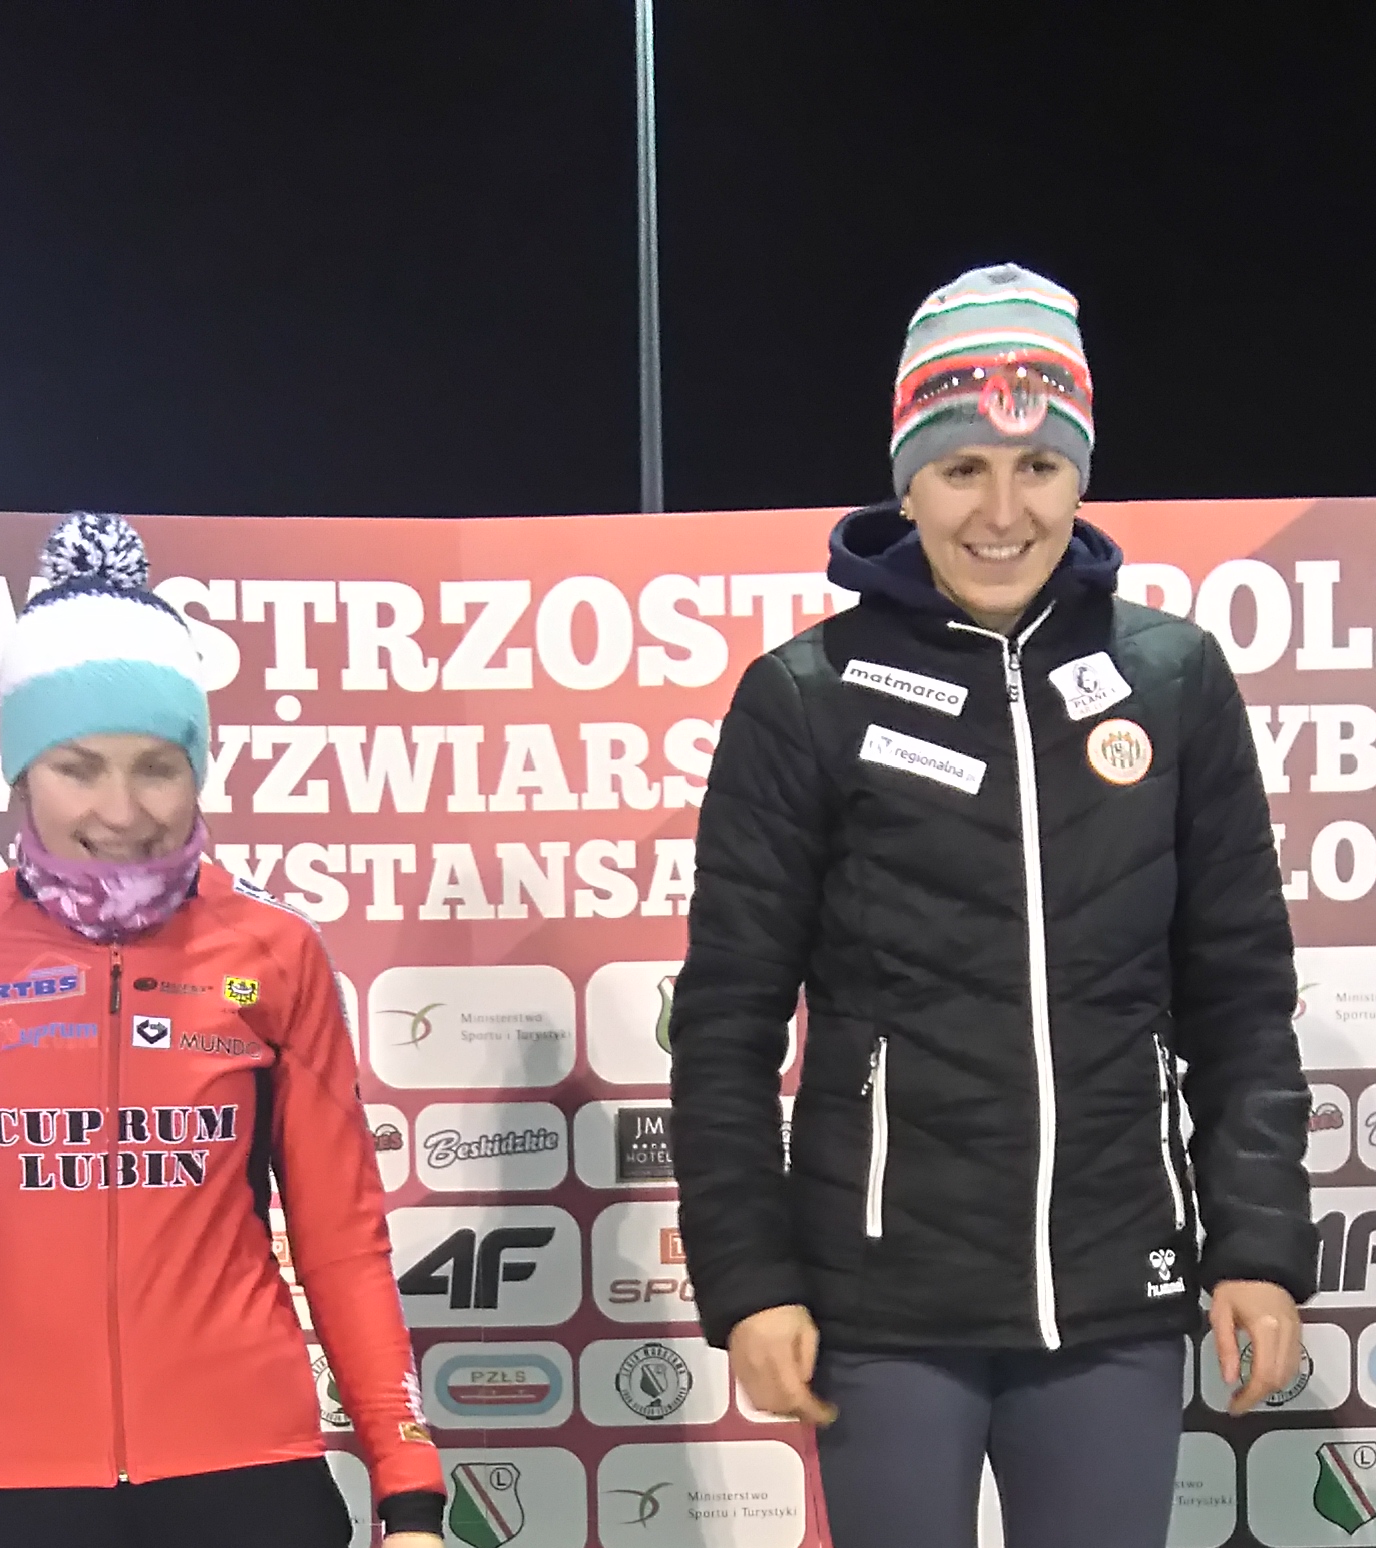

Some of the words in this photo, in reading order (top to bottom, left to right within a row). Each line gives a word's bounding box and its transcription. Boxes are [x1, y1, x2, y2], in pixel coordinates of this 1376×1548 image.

[849, 665, 960, 706] matmarco
[198, 694, 721, 813] YŻWIARS
[215, 839, 696, 922] YSTANSA
[1335, 1008, 1376, 1021] Sportu
[179, 1031, 262, 1060] MUNDO
[635, 1116, 664, 1139] JM
[423, 1128, 559, 1169] Beskidzkie
[625, 1150, 673, 1162] HOTEL
[17, 1150, 209, 1191] LUBIN
[397, 1227, 555, 1309] 4F
[470, 1369, 528, 1384] PZŁS
[687, 1489, 769, 1502] Ministerstwo
[687, 1507, 728, 1521] Sportu
[741, 1505, 798, 1520] Turystyki
